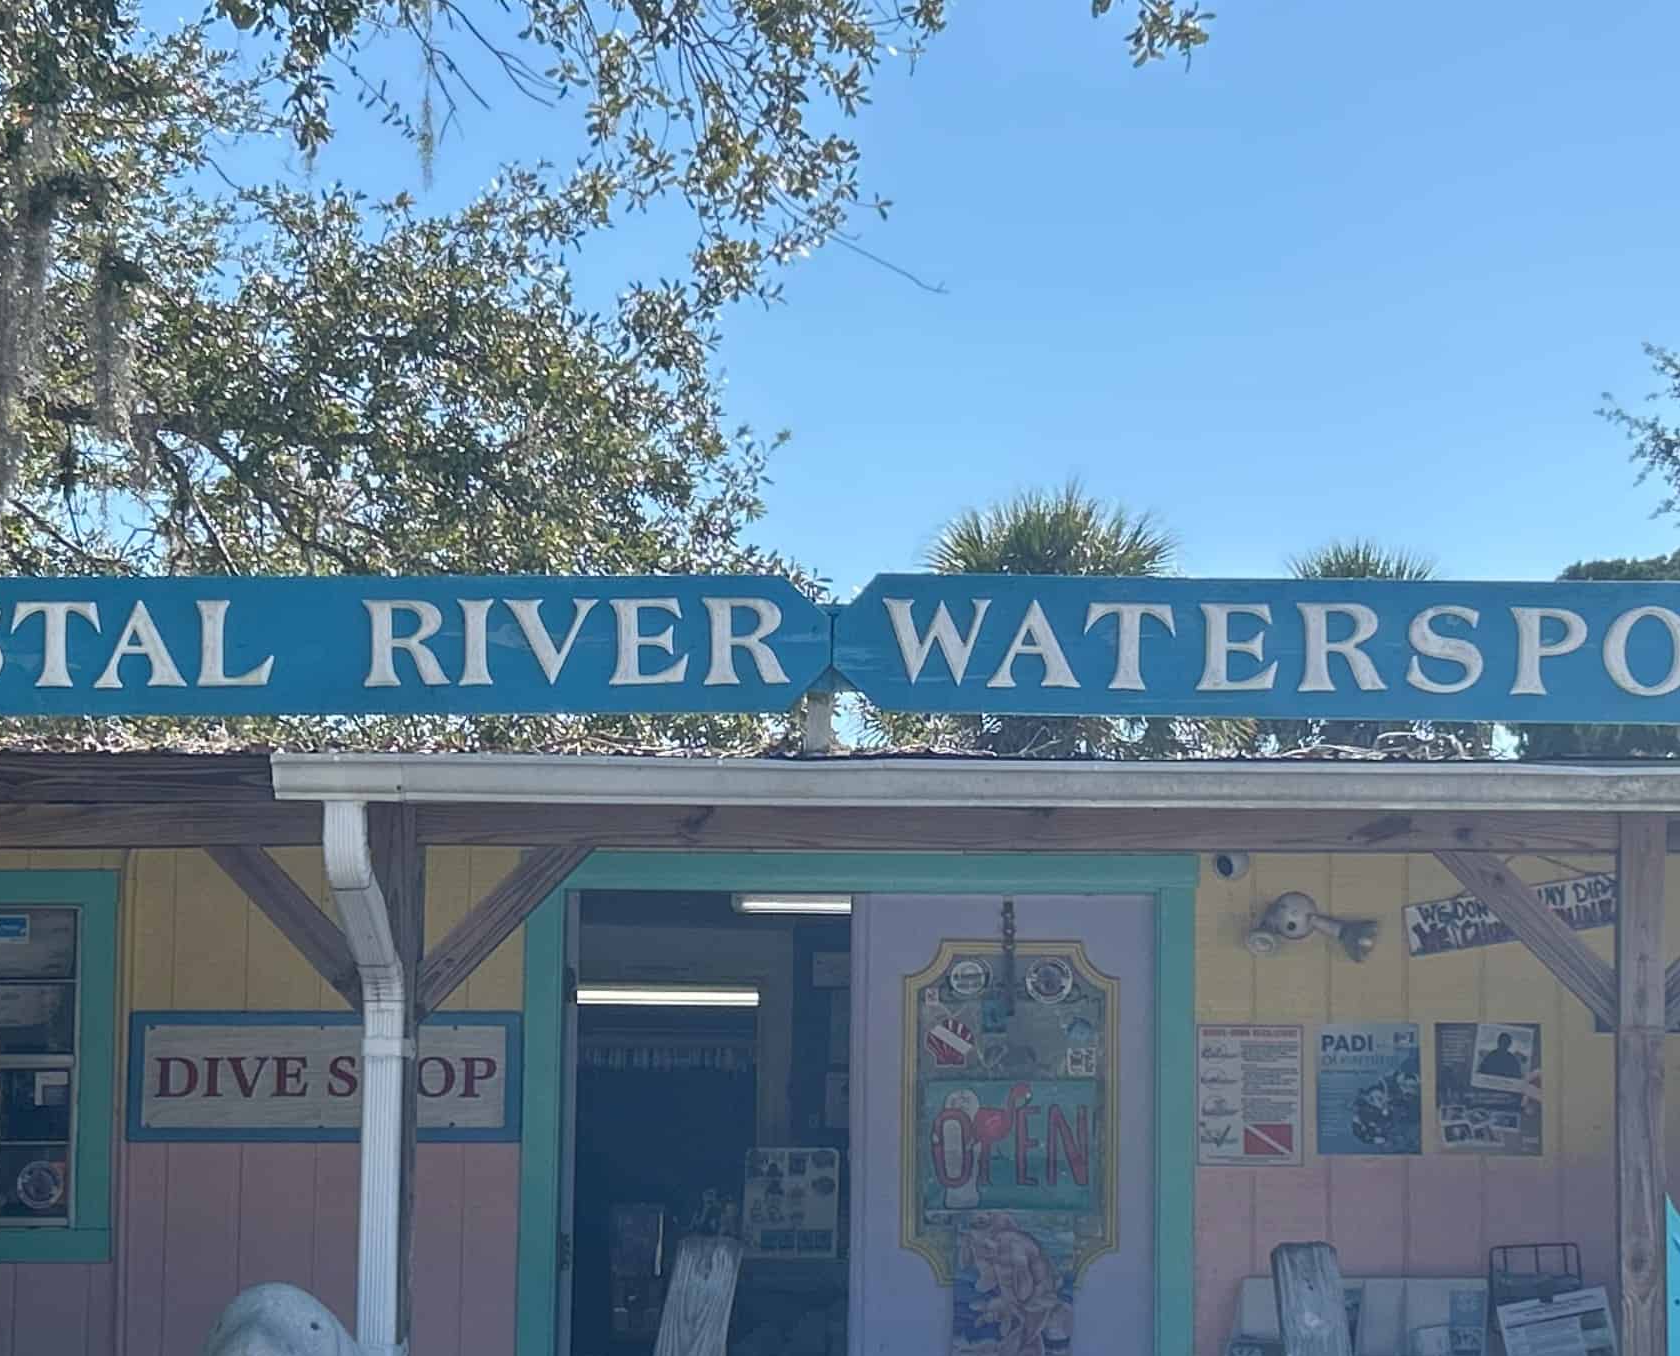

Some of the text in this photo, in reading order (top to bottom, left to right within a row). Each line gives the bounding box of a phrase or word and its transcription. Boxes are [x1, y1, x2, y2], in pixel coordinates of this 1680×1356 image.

[362, 597, 791, 688] RIVER
[1320, 1033, 1374, 1052] PADI
[153, 1054, 498, 1099] DIVE SOP
